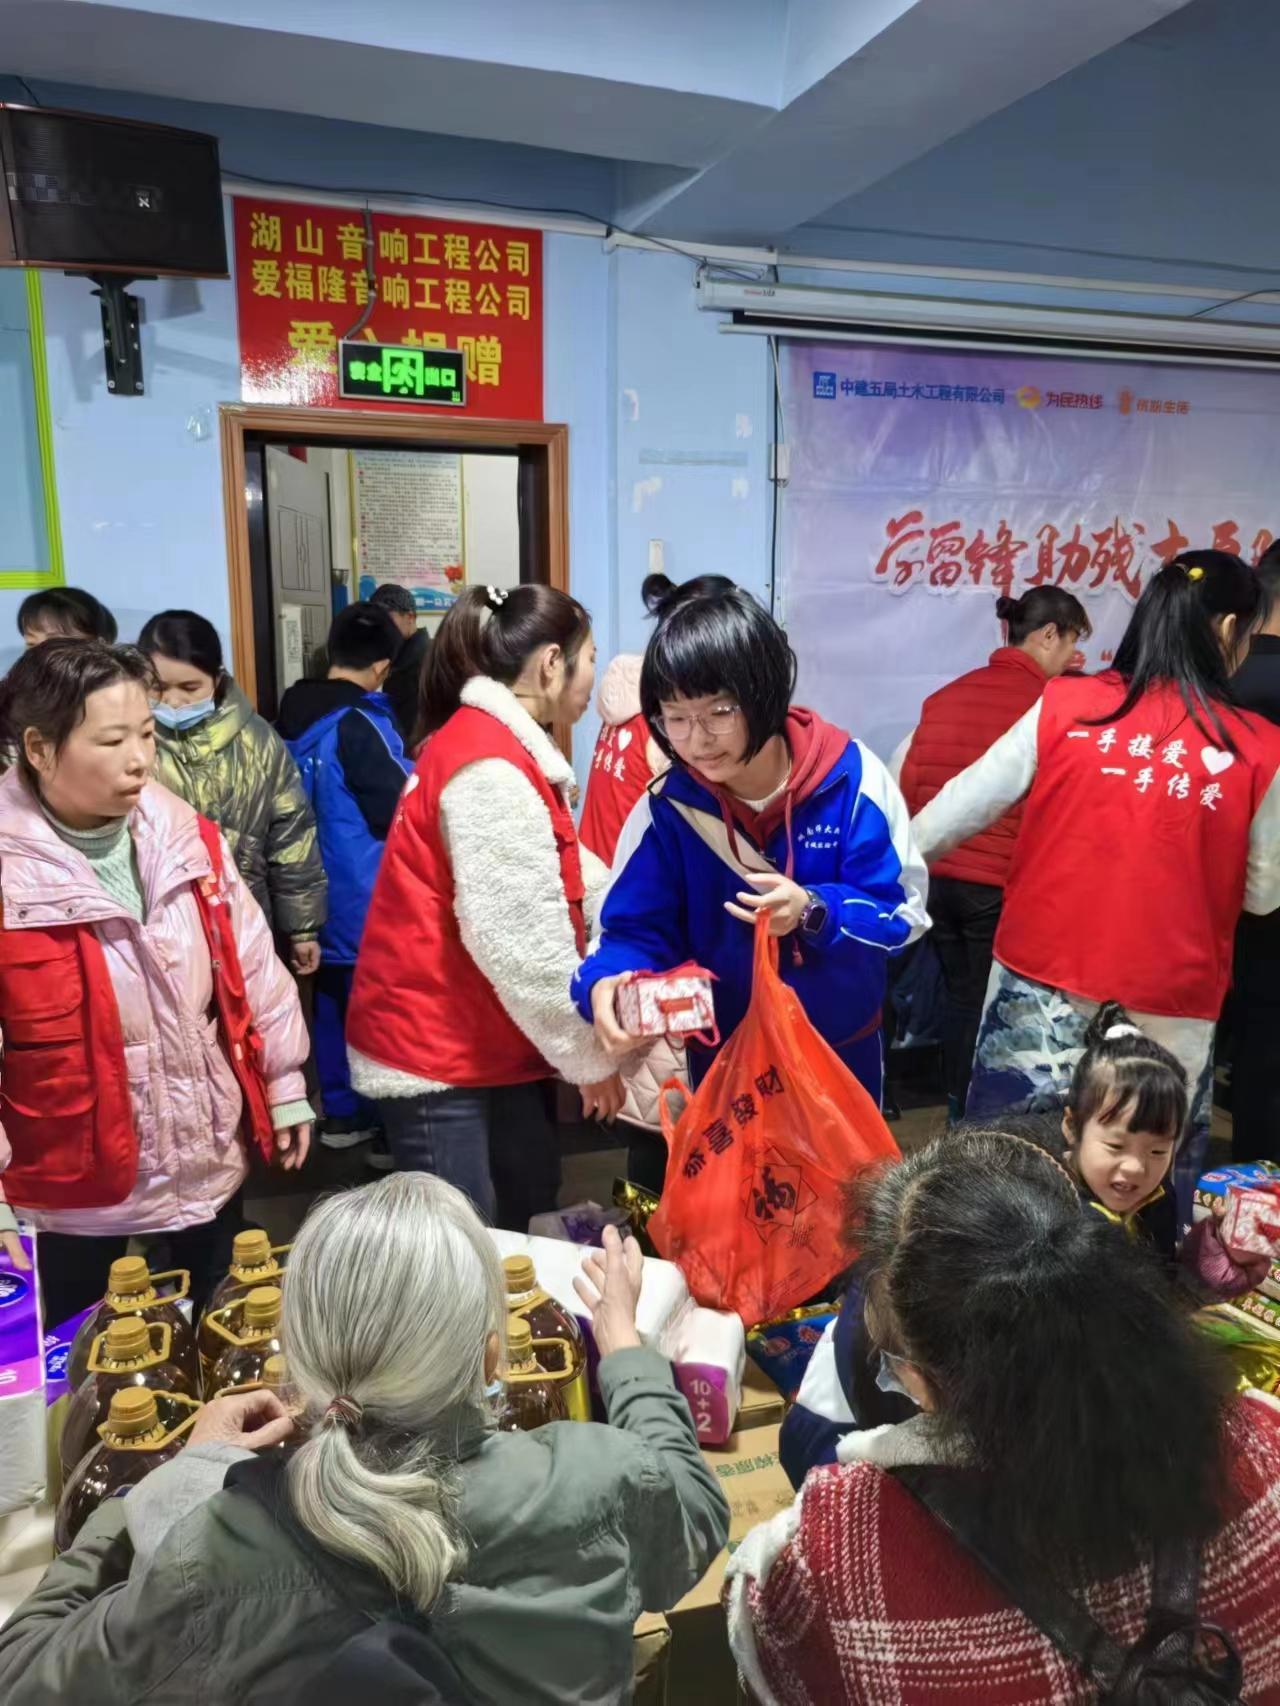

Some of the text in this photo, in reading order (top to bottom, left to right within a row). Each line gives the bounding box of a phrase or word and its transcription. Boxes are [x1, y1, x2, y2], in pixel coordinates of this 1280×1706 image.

[250, 212, 531, 277] 湖山音响工程公司
[251, 259, 531, 321] 爱福隆音响工程公司
[287, 320, 503, 387] 爱赠
[840, 378, 1006, 404] 中建五局土木工程有限公司
[1066, 727, 1188, 769] 一手接爱
[1101, 767, 1223, 811] 一手传爱
[690, 1380, 711, 1396] 10
[697, 1413, 712, 1433] 2
